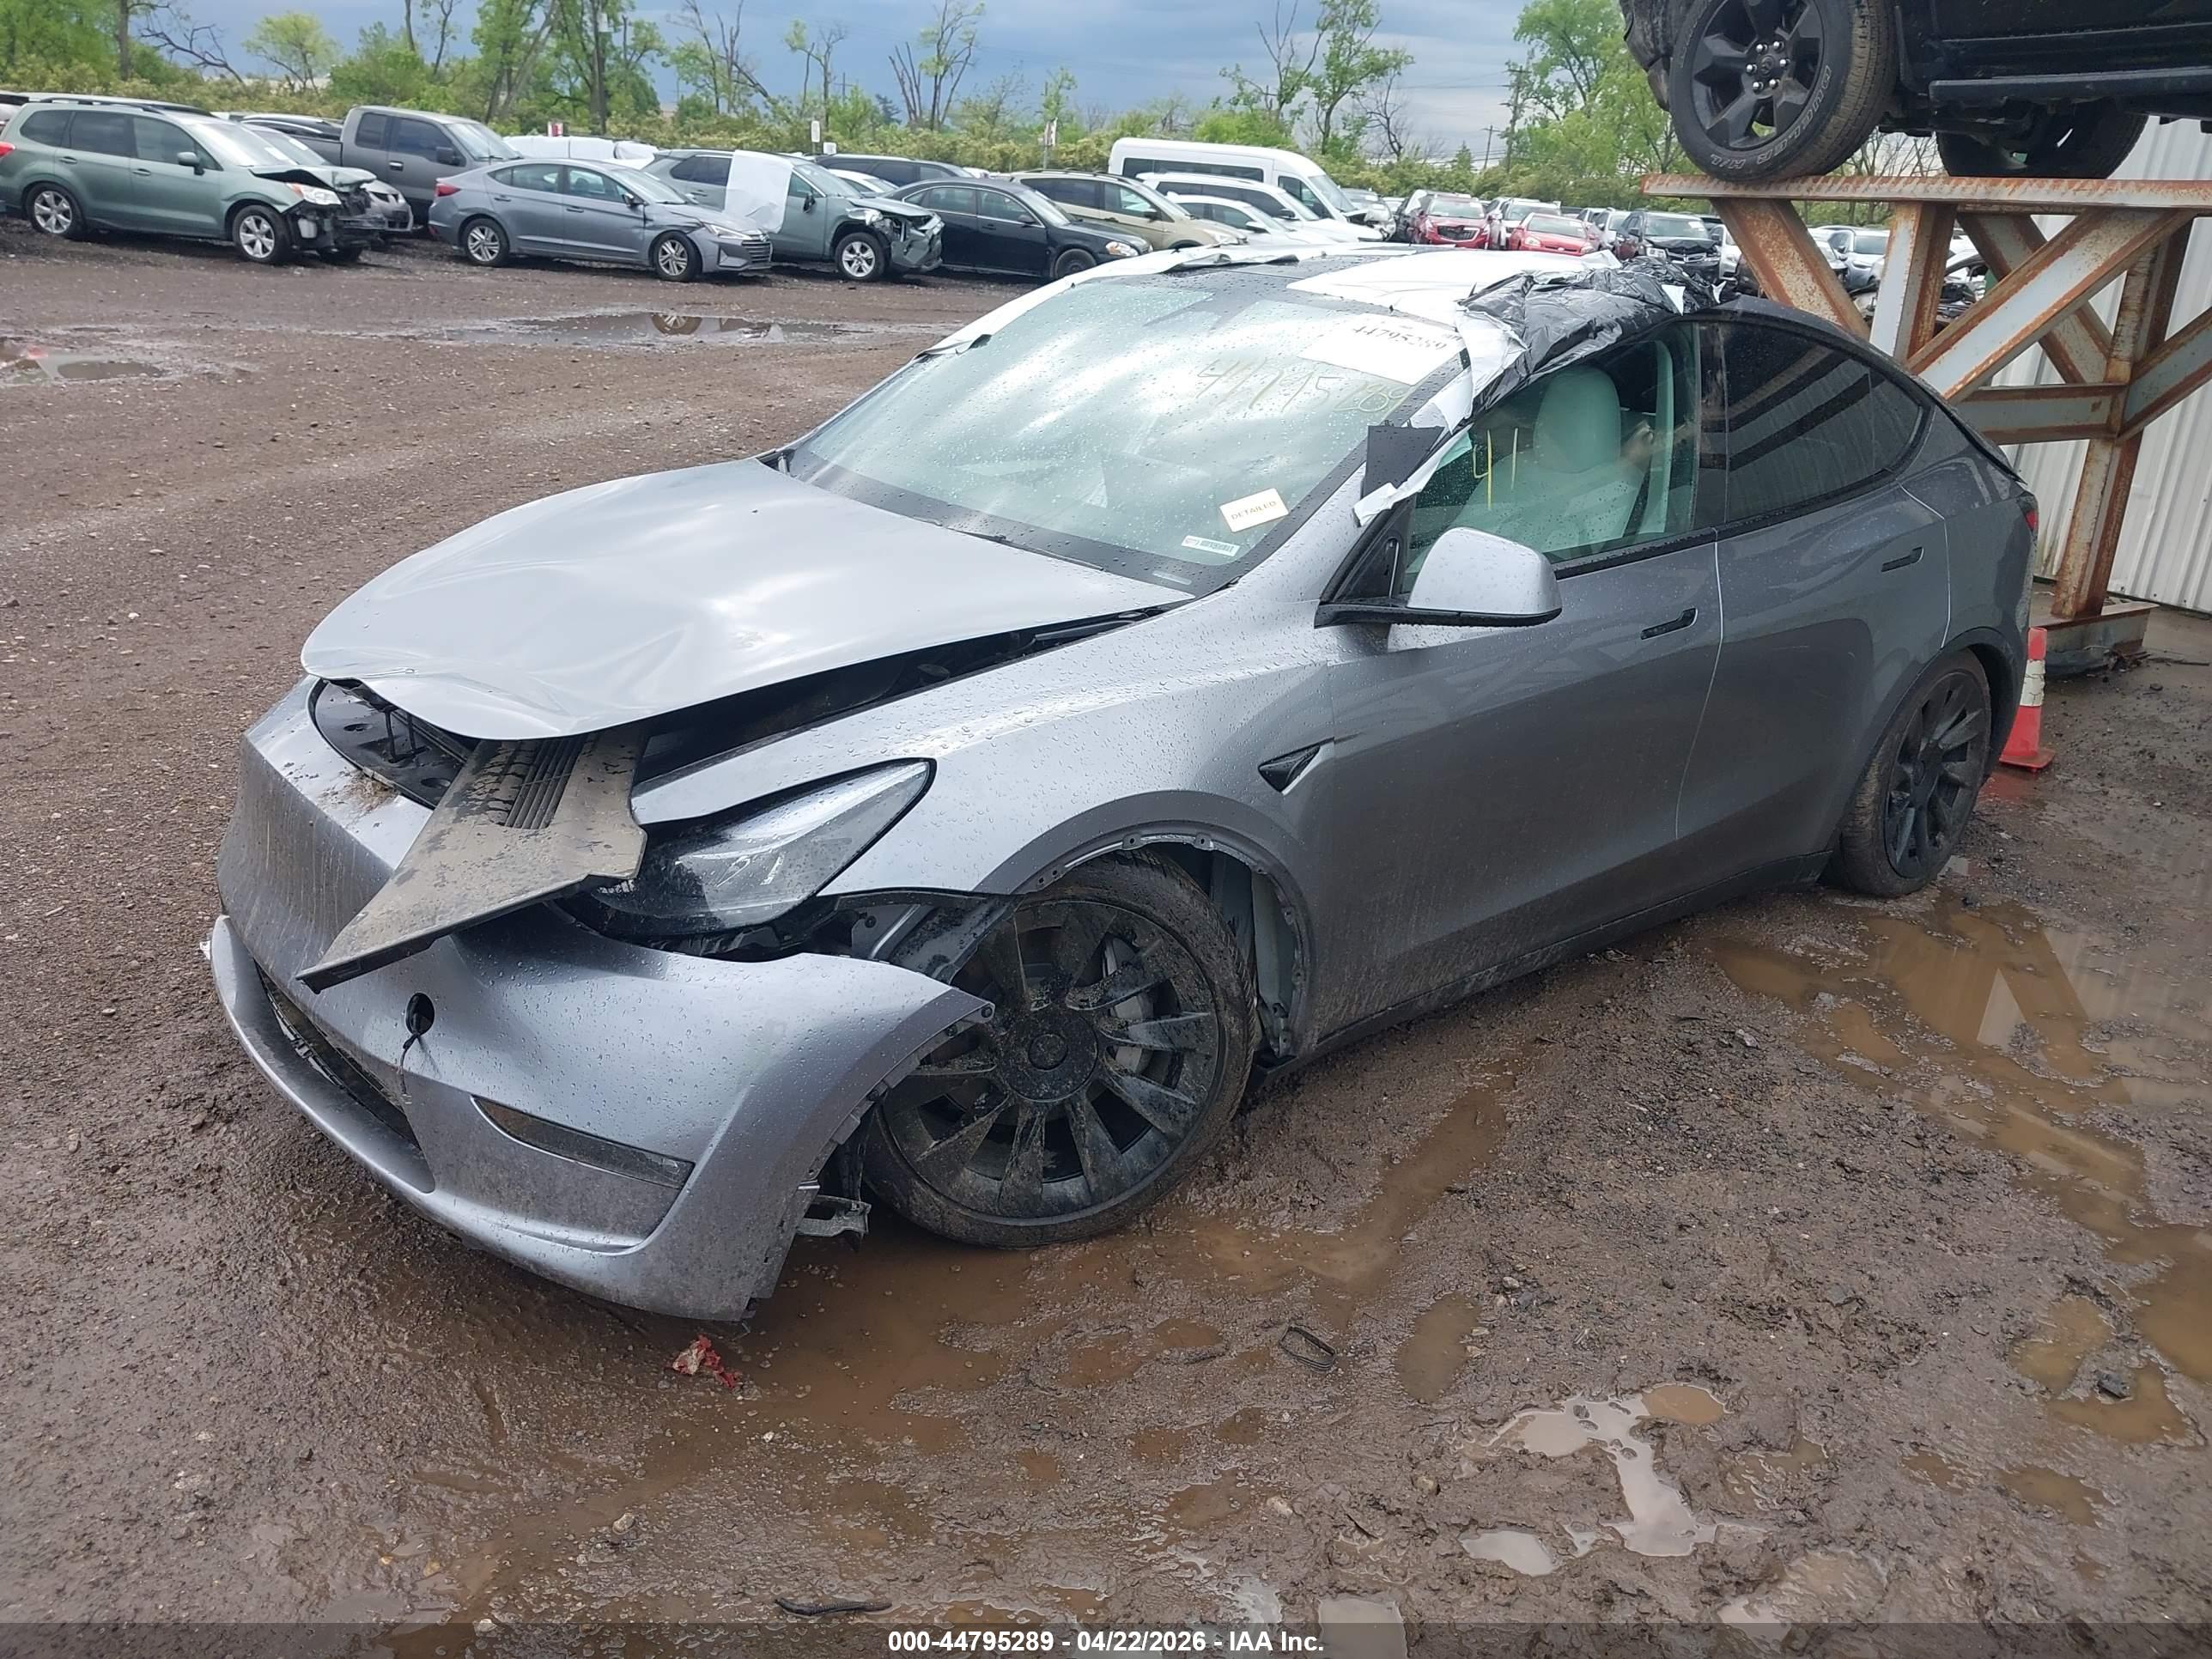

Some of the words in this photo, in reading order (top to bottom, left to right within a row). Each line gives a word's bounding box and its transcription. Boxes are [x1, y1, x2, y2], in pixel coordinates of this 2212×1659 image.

[1756, 64, 1832, 165] DUELER
[1710, 153, 1747, 169] H/L
[1230, 501, 1277, 520] DETAILED
